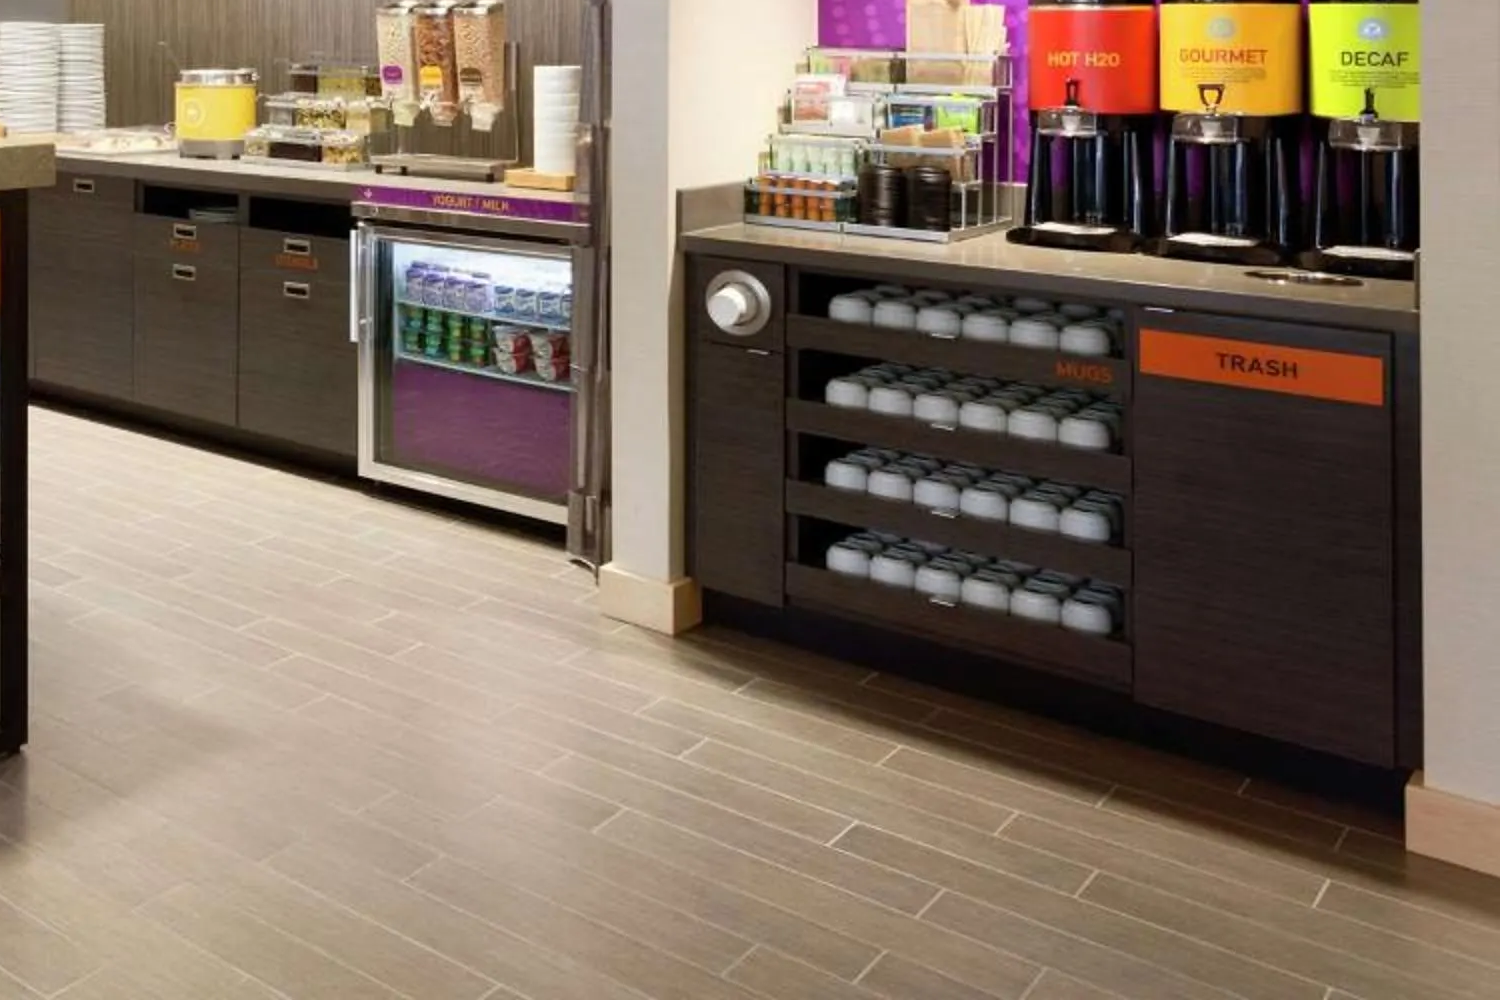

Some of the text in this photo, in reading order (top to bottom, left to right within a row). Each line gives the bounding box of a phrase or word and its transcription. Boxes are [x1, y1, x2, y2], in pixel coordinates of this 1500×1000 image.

[1047, 51, 1079, 68] HOT
[1179, 48, 1269, 66] GOURMET
[1340, 51, 1410, 67] DECAF
[1056, 360, 1113, 384] MUGS
[1216, 352, 1298, 379] TRASH
